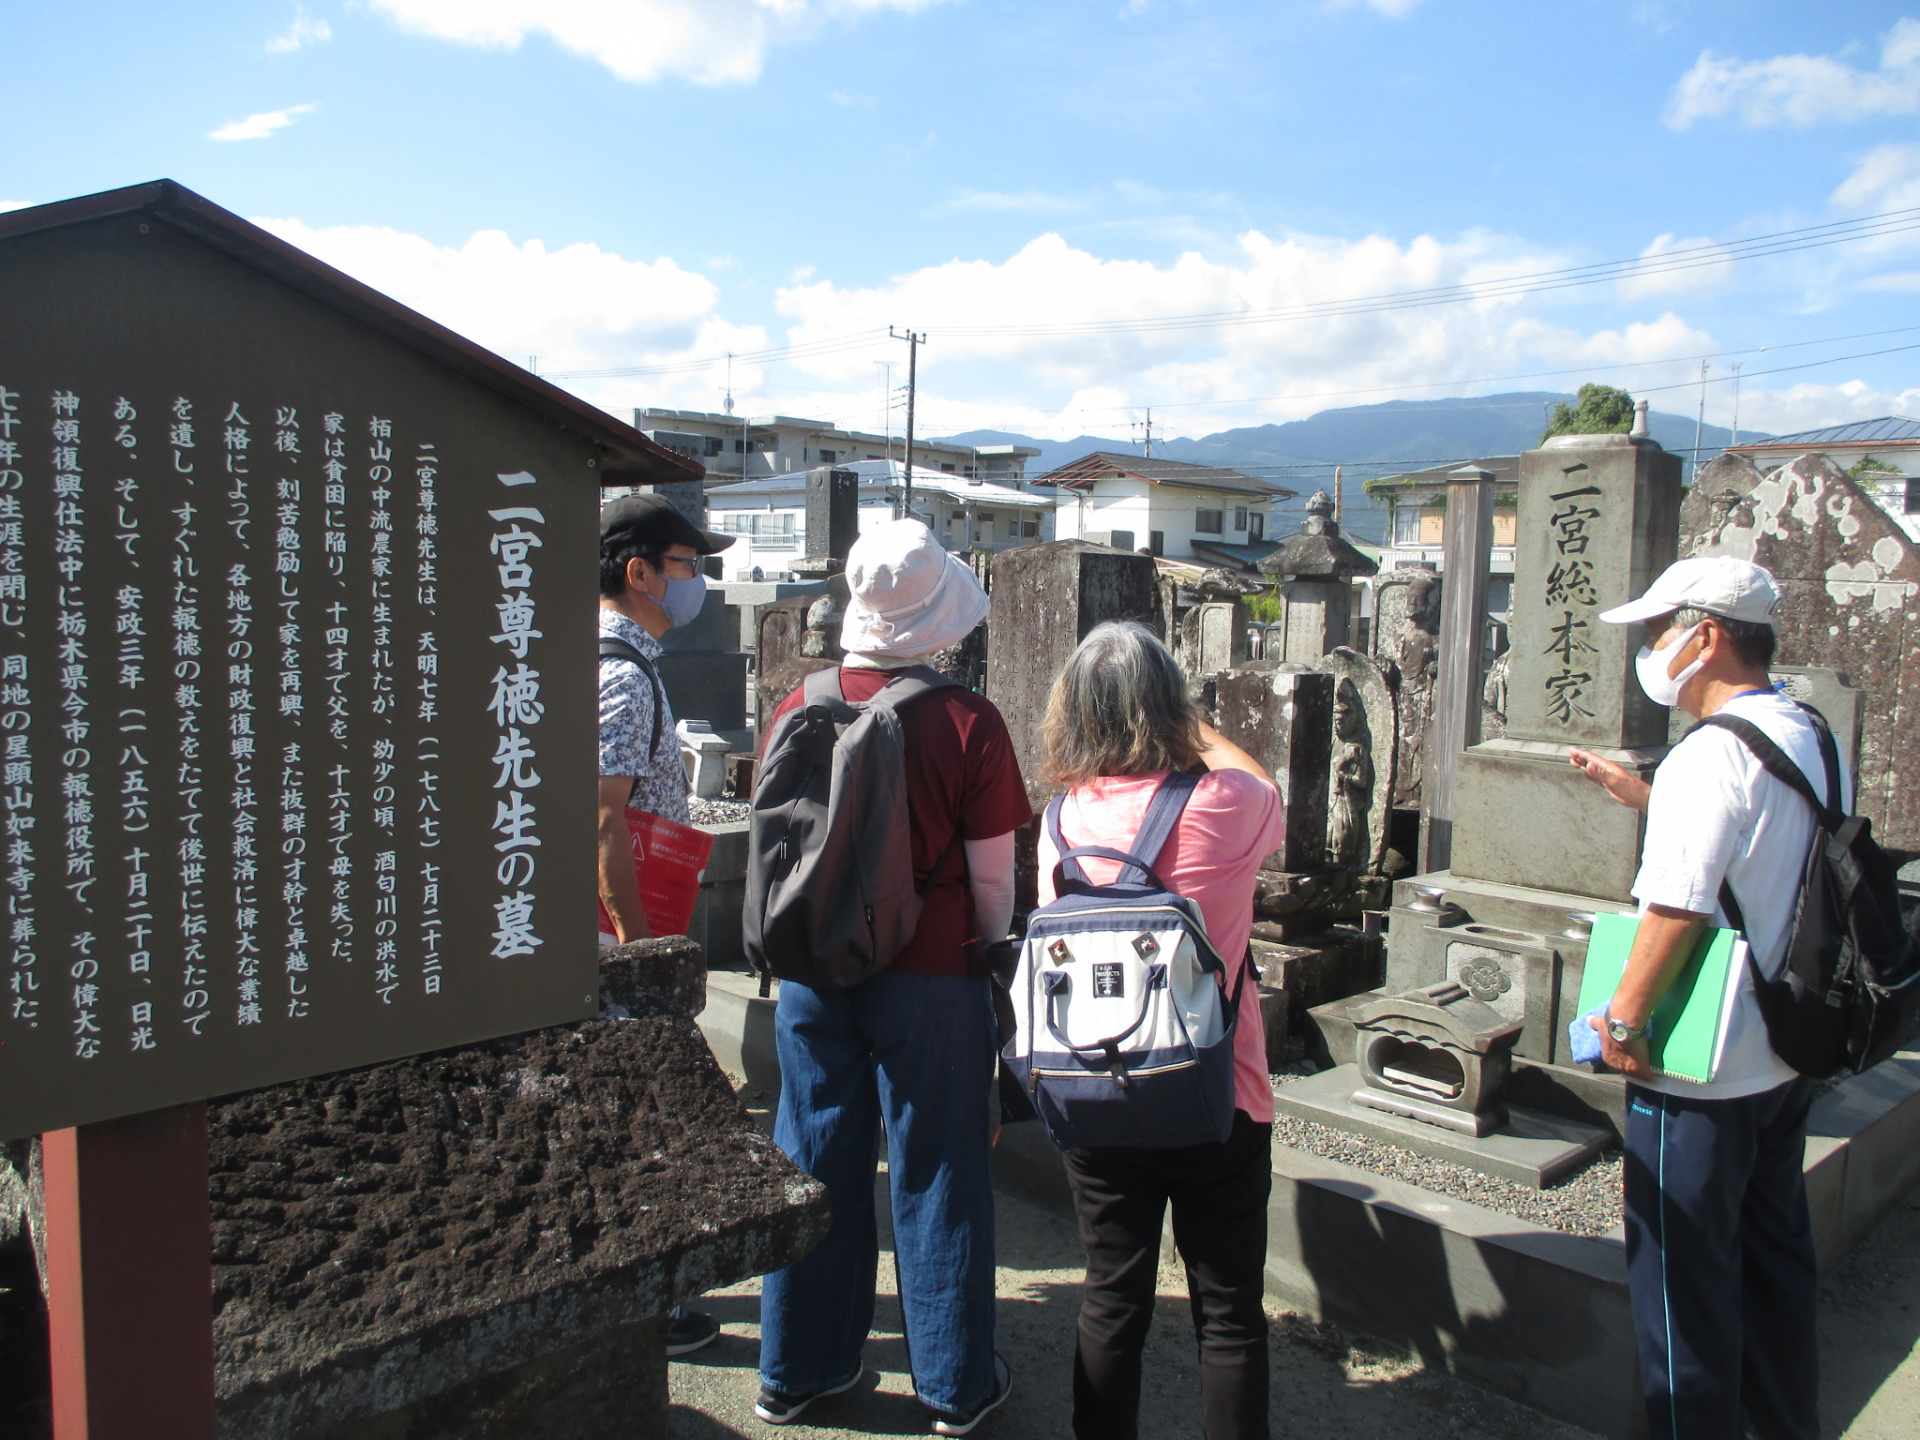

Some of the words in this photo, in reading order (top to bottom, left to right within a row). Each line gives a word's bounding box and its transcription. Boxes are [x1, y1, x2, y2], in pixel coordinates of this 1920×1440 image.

[487, 471, 545, 958] 二宮尊徳先生の墓
[1544, 464, 1602, 724] 二宮総本家
